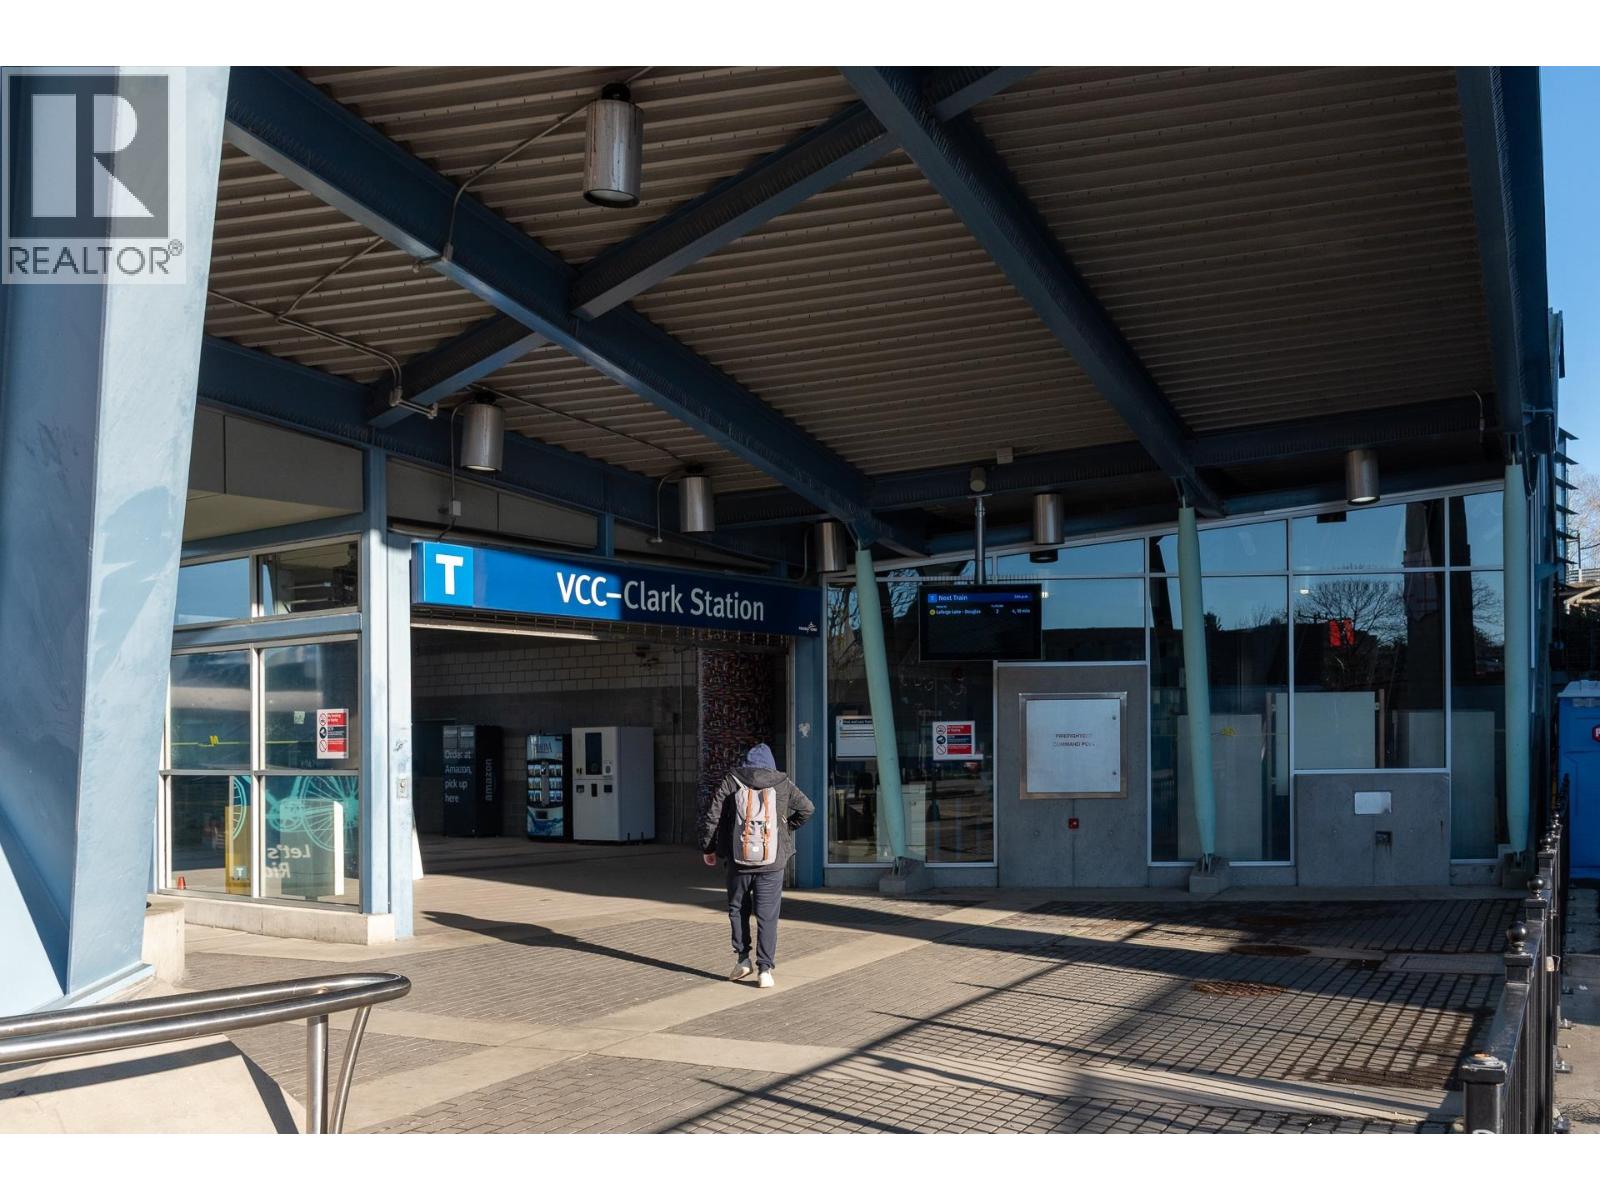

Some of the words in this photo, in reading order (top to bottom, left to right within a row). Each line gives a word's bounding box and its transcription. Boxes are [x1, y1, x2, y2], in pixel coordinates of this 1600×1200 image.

[435, 553, 464, 595] T
[689, 587, 764, 622] Station
[445, 779, 457, 789] pick
[458, 781, 468, 790] up
[445, 794, 459, 803] here
